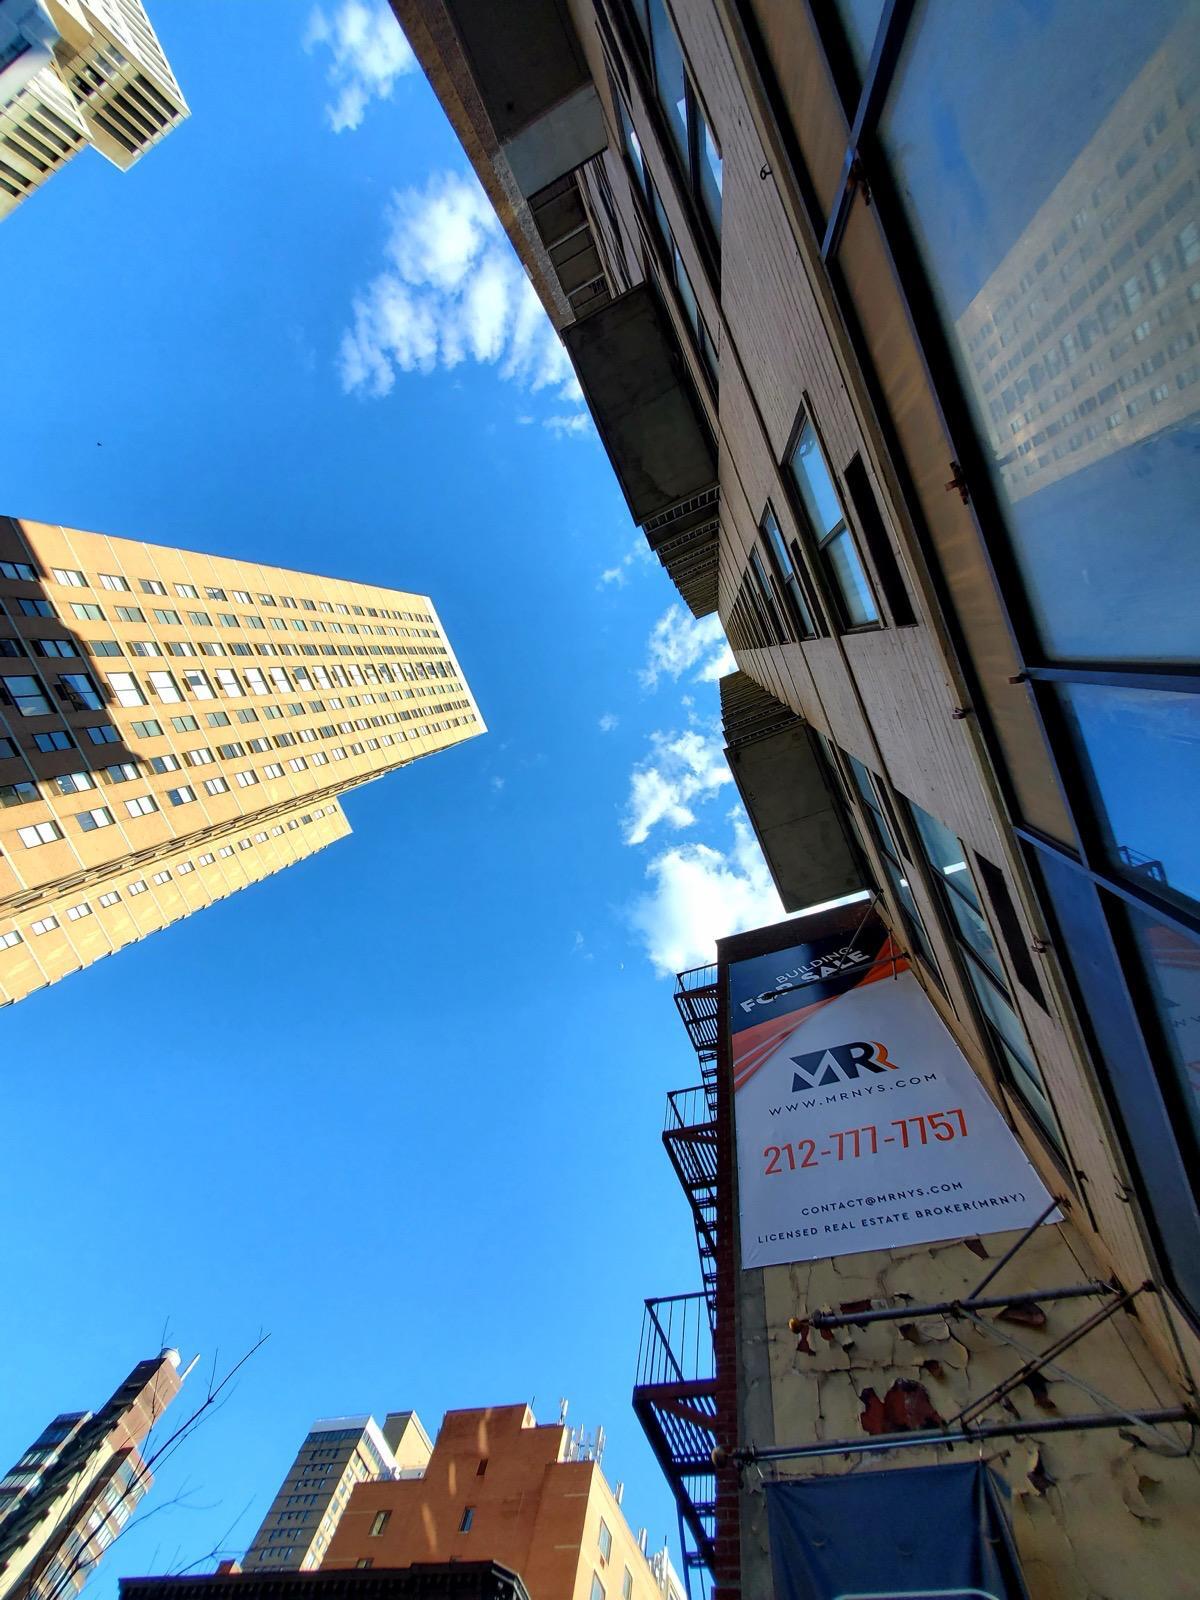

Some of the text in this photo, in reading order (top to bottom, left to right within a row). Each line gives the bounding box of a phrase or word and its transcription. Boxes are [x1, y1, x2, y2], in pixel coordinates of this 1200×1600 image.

[776, 947, 853, 983] BUILDING
[801, 950, 870, 981] SALE
[769, 1073, 937, 1116] WWW.MRNYS.COM
[763, 1108, 968, 1175] 212-777-7757
[758, 1192, 1026, 1244] LICENSED REAL ESTATE BROKER(MRNY)
[801, 1181, 963, 1216] CONTACT@MRNYS.COM
